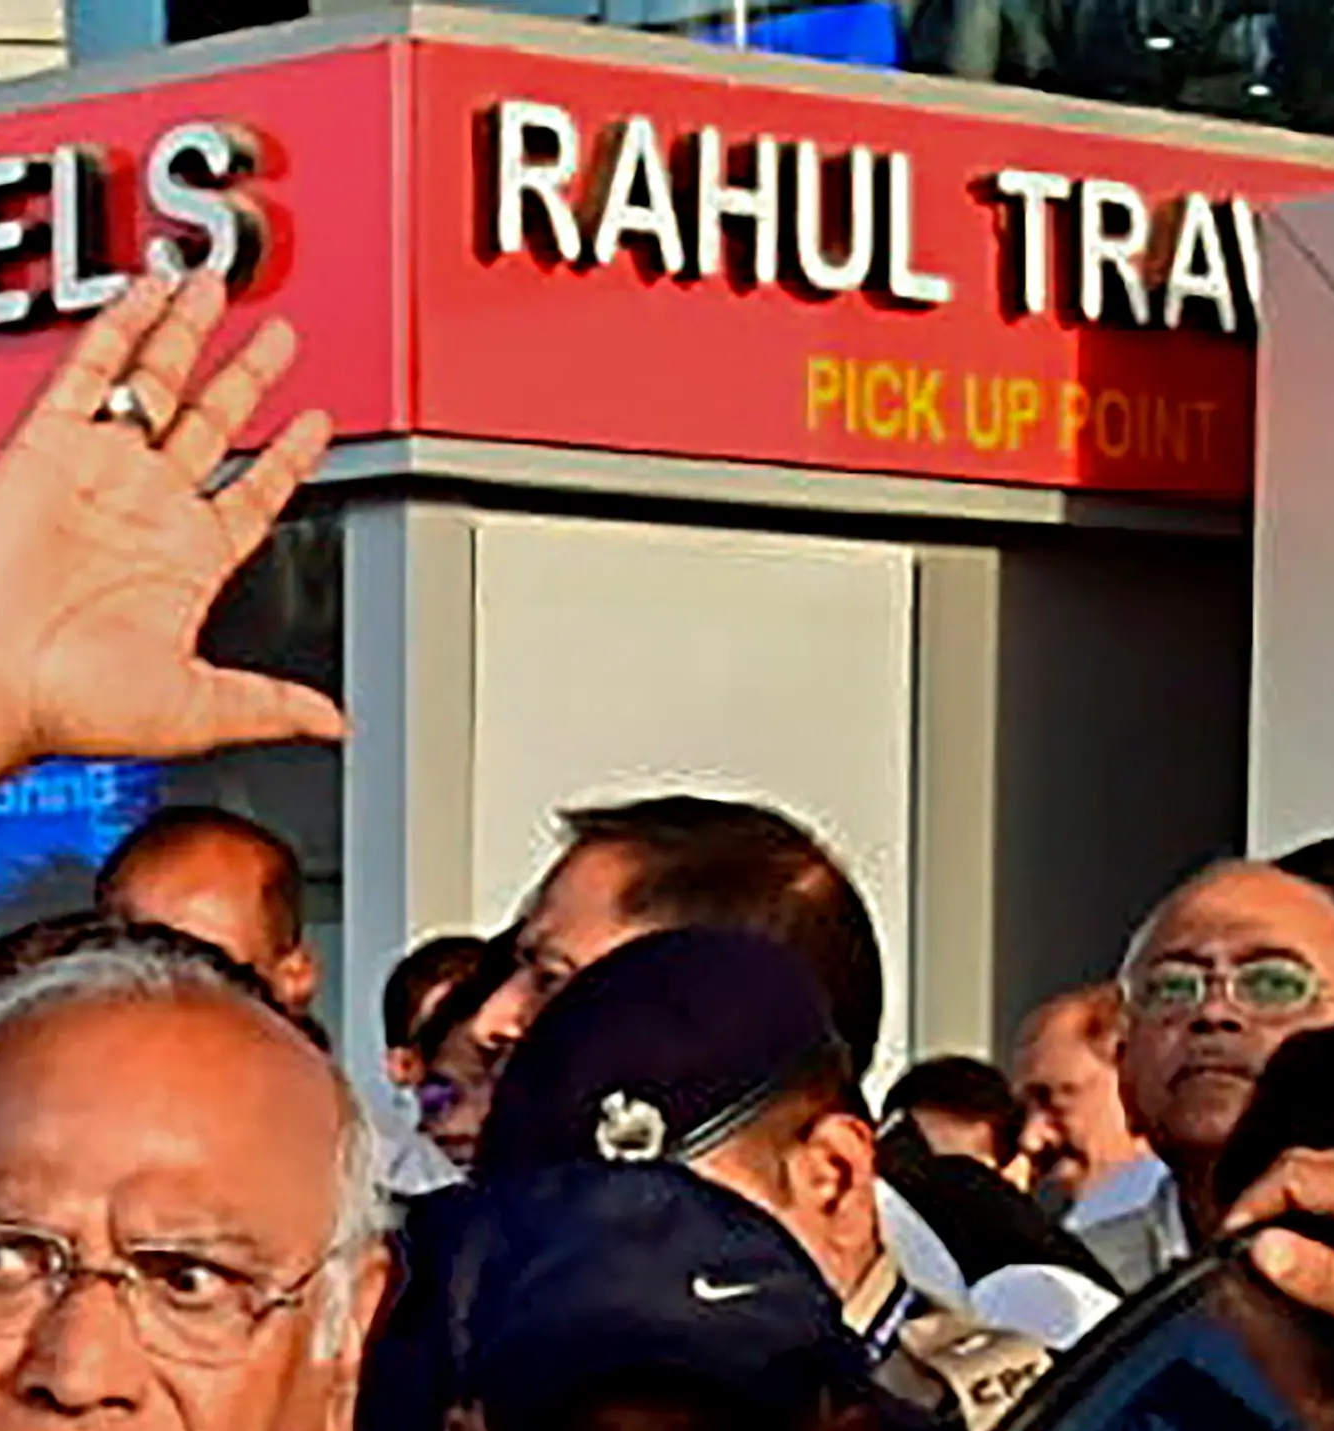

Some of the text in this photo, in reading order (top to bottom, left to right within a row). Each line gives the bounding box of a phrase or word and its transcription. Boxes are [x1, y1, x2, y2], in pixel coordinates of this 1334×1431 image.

[495, 98, 953, 305] RAHUL
[806, 356, 1217, 464] PICK UP POINT
